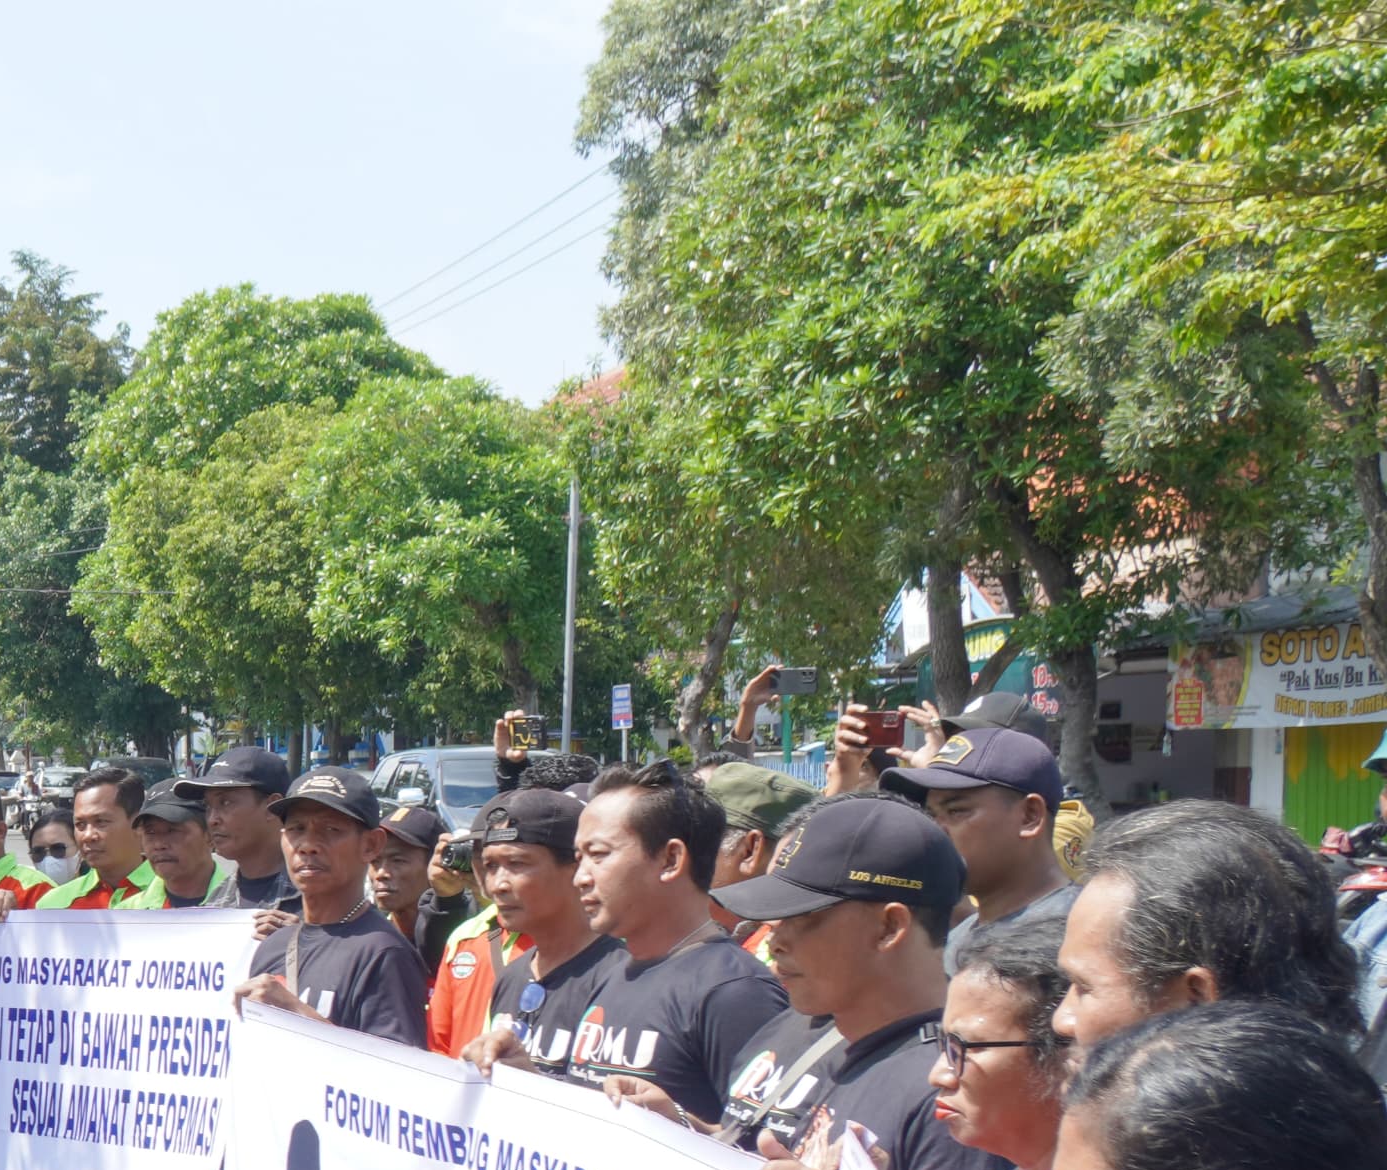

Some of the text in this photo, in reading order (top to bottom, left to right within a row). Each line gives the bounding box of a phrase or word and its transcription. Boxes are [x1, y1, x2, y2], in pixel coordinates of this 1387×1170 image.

[1260, 626, 1340, 667] SOTO
[849, 870, 924, 890] LOS ANGELES
[17, 957, 131, 988] MASYARAKAT
[135, 960, 225, 992] JOMBANG
[7, 1007, 56, 1064] TETAP
[59, 1010, 76, 1067] DI
[79, 1011, 144, 1071] BAWAH
[10, 1078, 223, 1157] SESUAI AMANAT REFORMASI
[325, 1085, 391, 1145] FORUM
